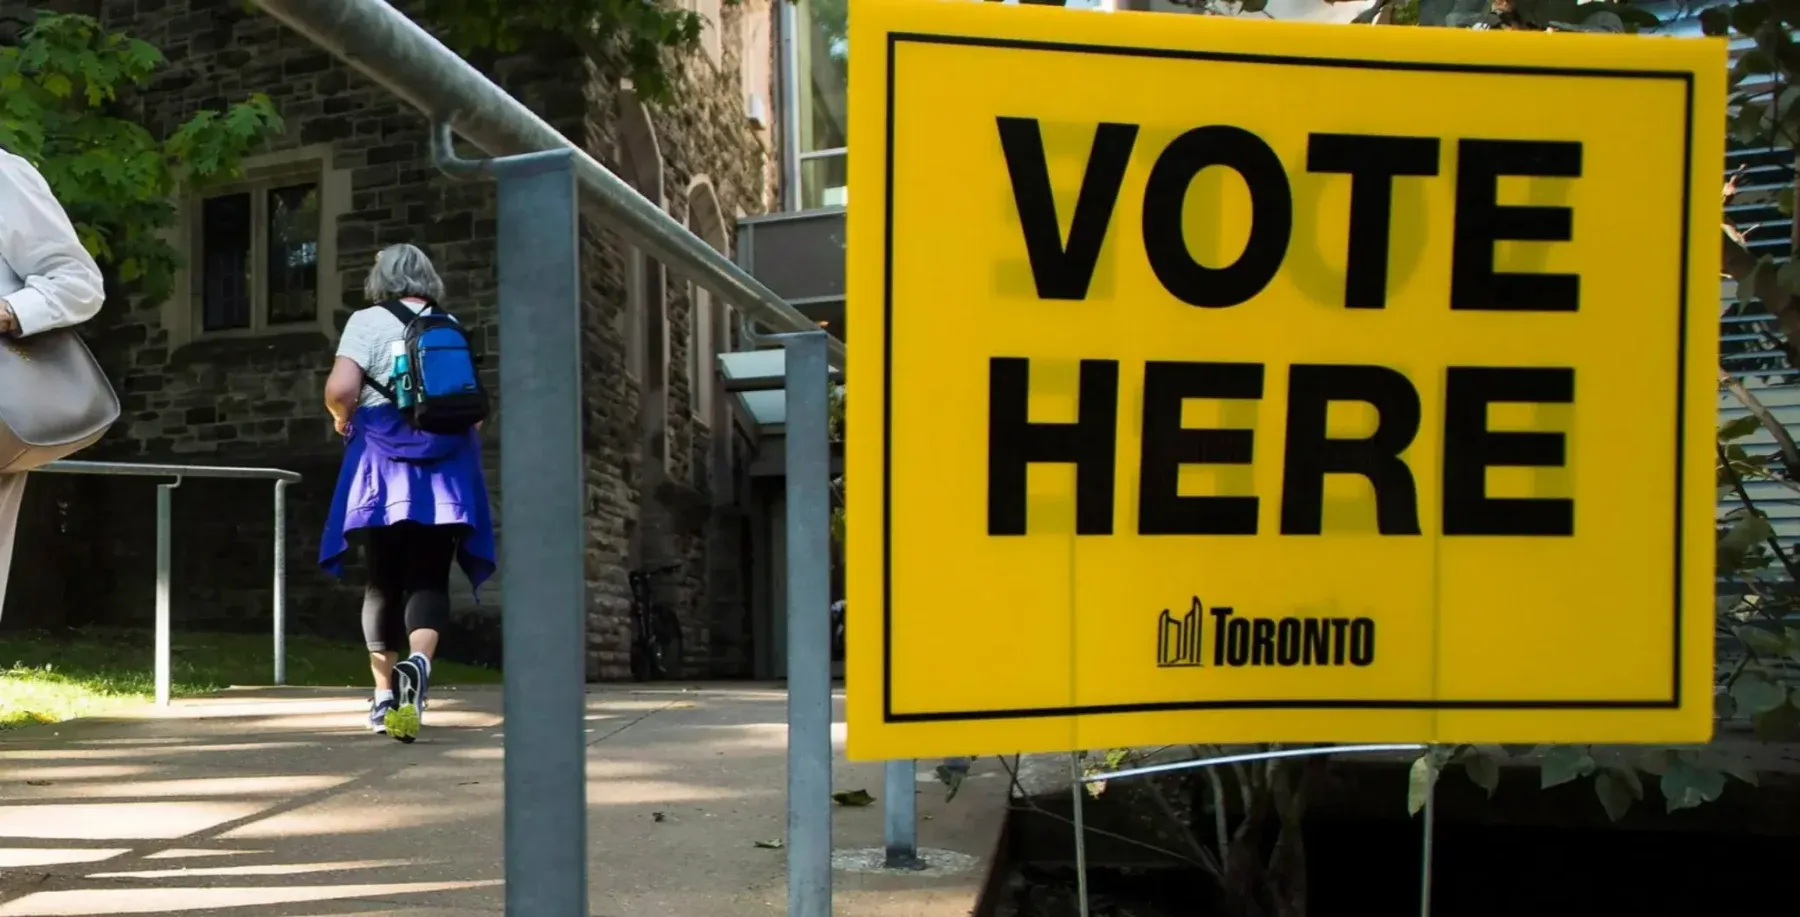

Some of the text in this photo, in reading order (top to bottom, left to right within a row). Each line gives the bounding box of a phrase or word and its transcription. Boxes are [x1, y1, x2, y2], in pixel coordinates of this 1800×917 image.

[996, 116, 1583, 312] VOTE
[988, 357, 1576, 537] HERE
[1210, 606, 1376, 667] TORONTO
